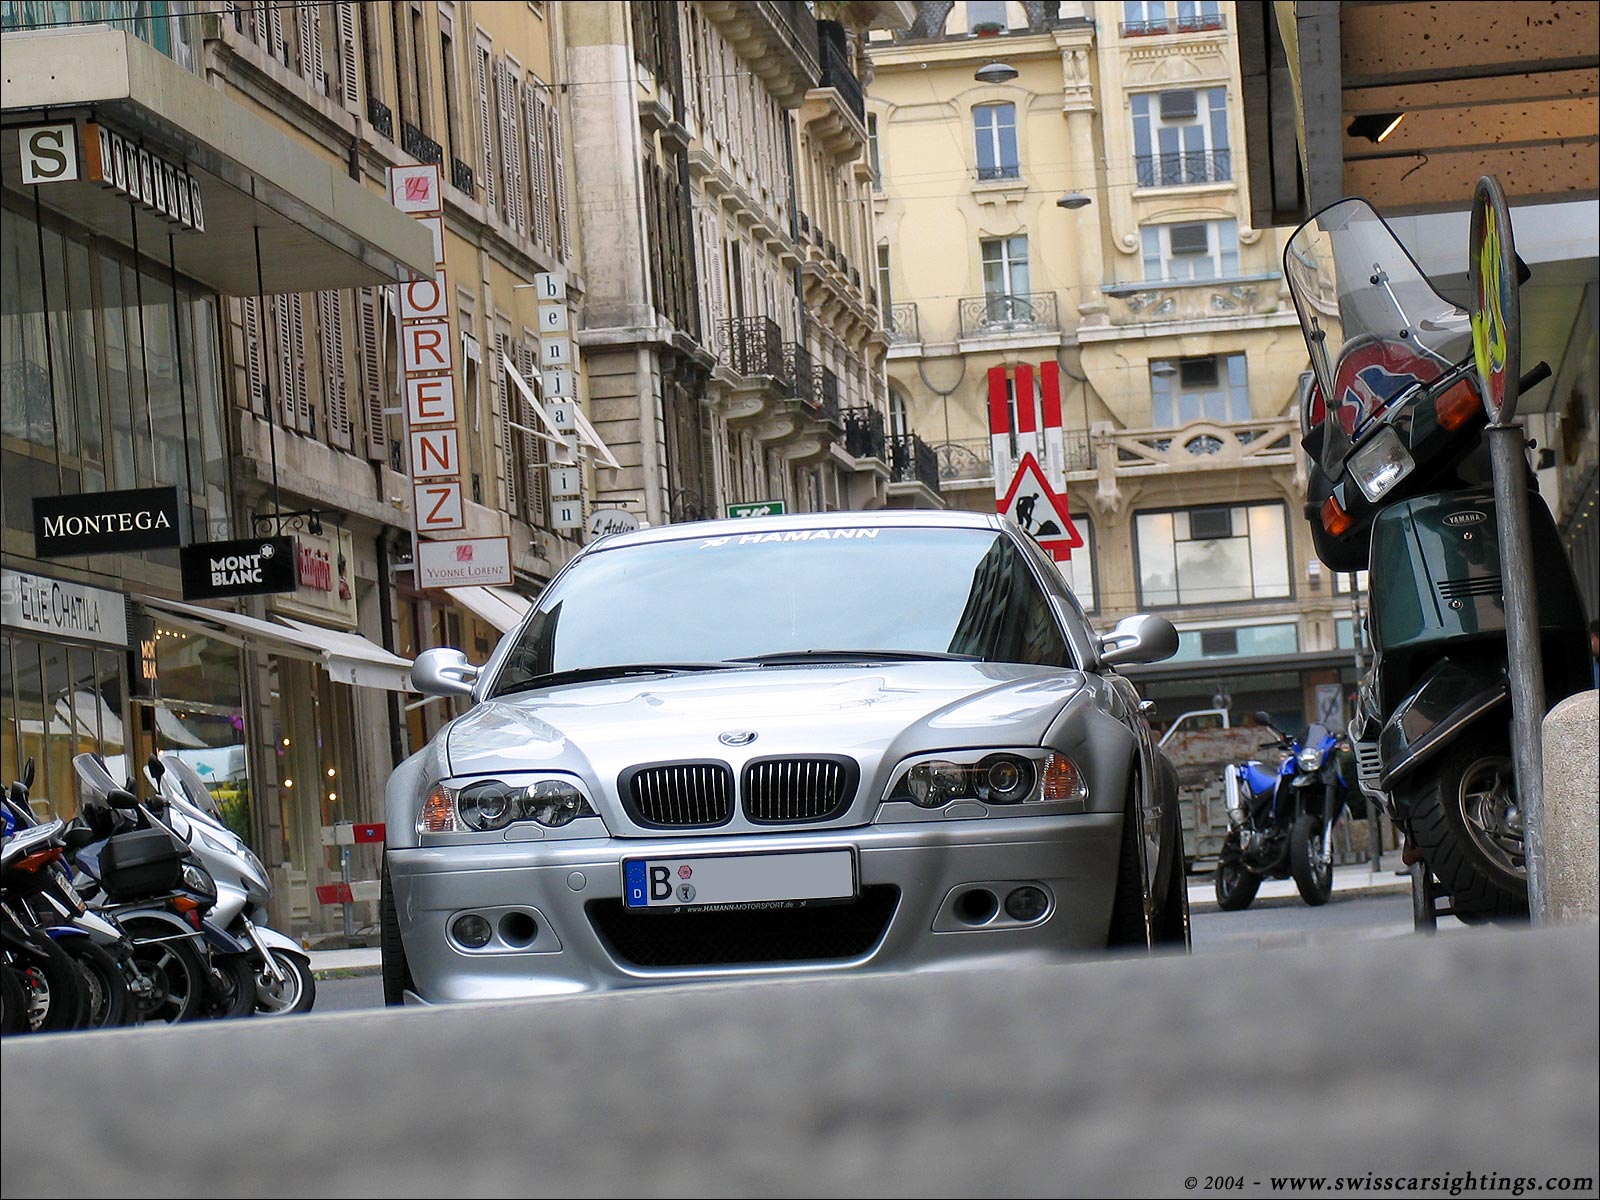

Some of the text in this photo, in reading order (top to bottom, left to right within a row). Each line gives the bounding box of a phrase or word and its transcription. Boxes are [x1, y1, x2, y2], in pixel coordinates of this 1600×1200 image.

[29, 130, 67, 178] S
[99, 129, 204, 228] LONGINES
[406, 276, 455, 525] ORENZ
[545, 275, 572, 522] benjain
[42, 510, 171, 538] MONTEGA
[1449, 514, 1480, 523] YAMAHA
[738, 528, 880, 545] HAMANN
[210, 554, 261, 572] MONT
[427, 565, 504, 578] YVONNE LORENZ
[211, 568, 263, 587] BLANC
[20, 576, 101, 634] ELIE CHATILA
[633, 888, 642, 899] D
[650, 866, 673, 901] B
